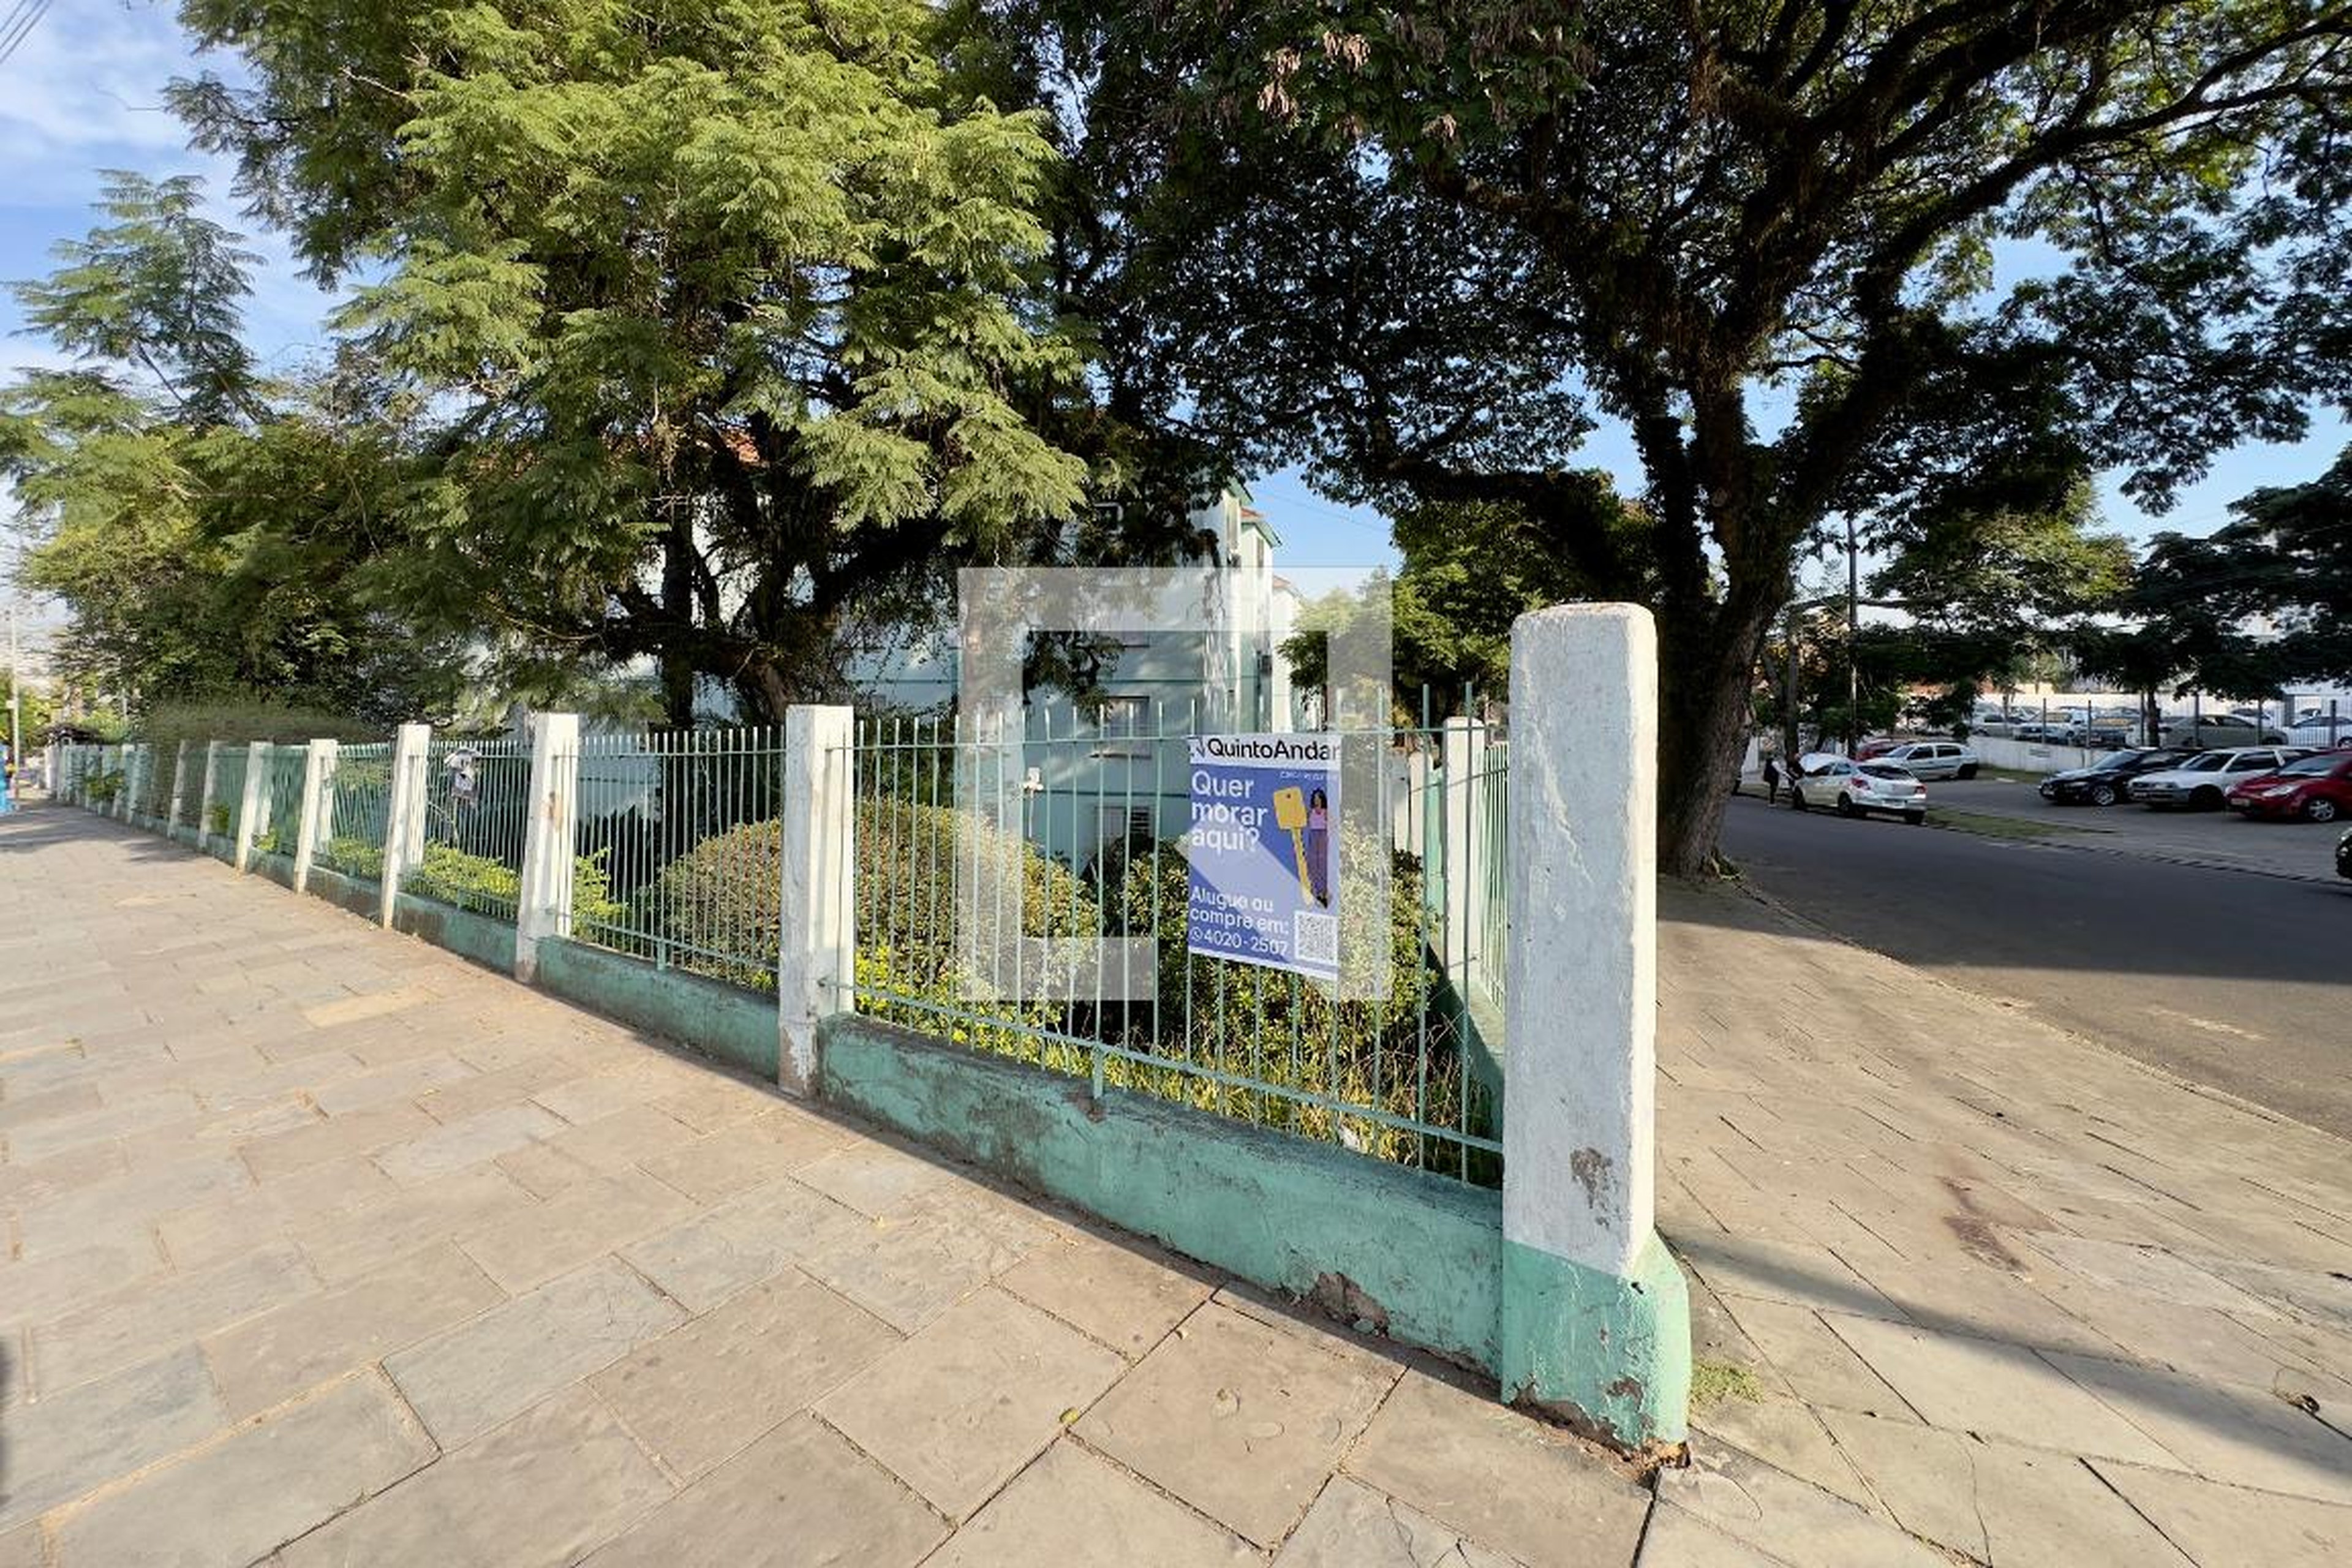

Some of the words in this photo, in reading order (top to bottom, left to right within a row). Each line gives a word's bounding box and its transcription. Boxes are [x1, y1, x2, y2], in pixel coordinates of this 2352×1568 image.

[1192, 771, 1254, 798] Quer
[1192, 802, 1268, 826] morar
[1192, 827, 1260, 856] aqui?
[1252, 898, 1273, 912] ou
[1257, 918, 1289, 935] em:
